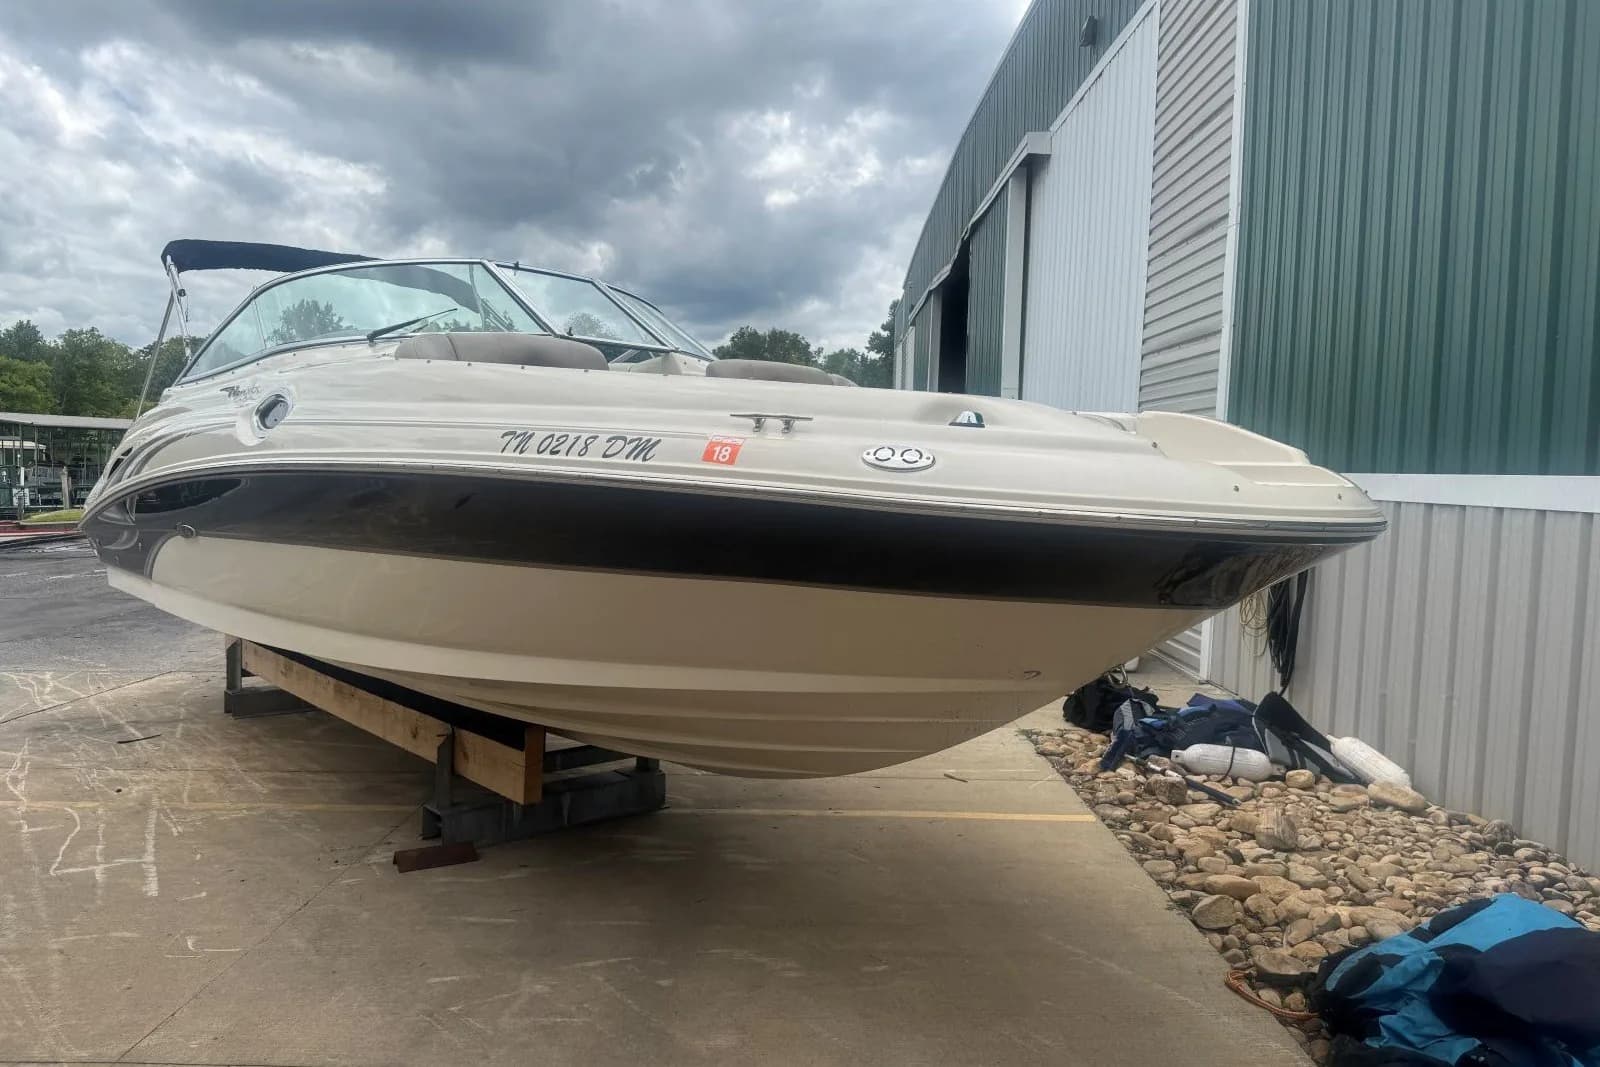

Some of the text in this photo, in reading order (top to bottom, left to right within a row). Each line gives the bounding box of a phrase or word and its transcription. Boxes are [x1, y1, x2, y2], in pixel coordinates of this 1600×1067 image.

[500, 430, 662, 462] TN 0218 DM
[712, 445, 732, 462] 18
